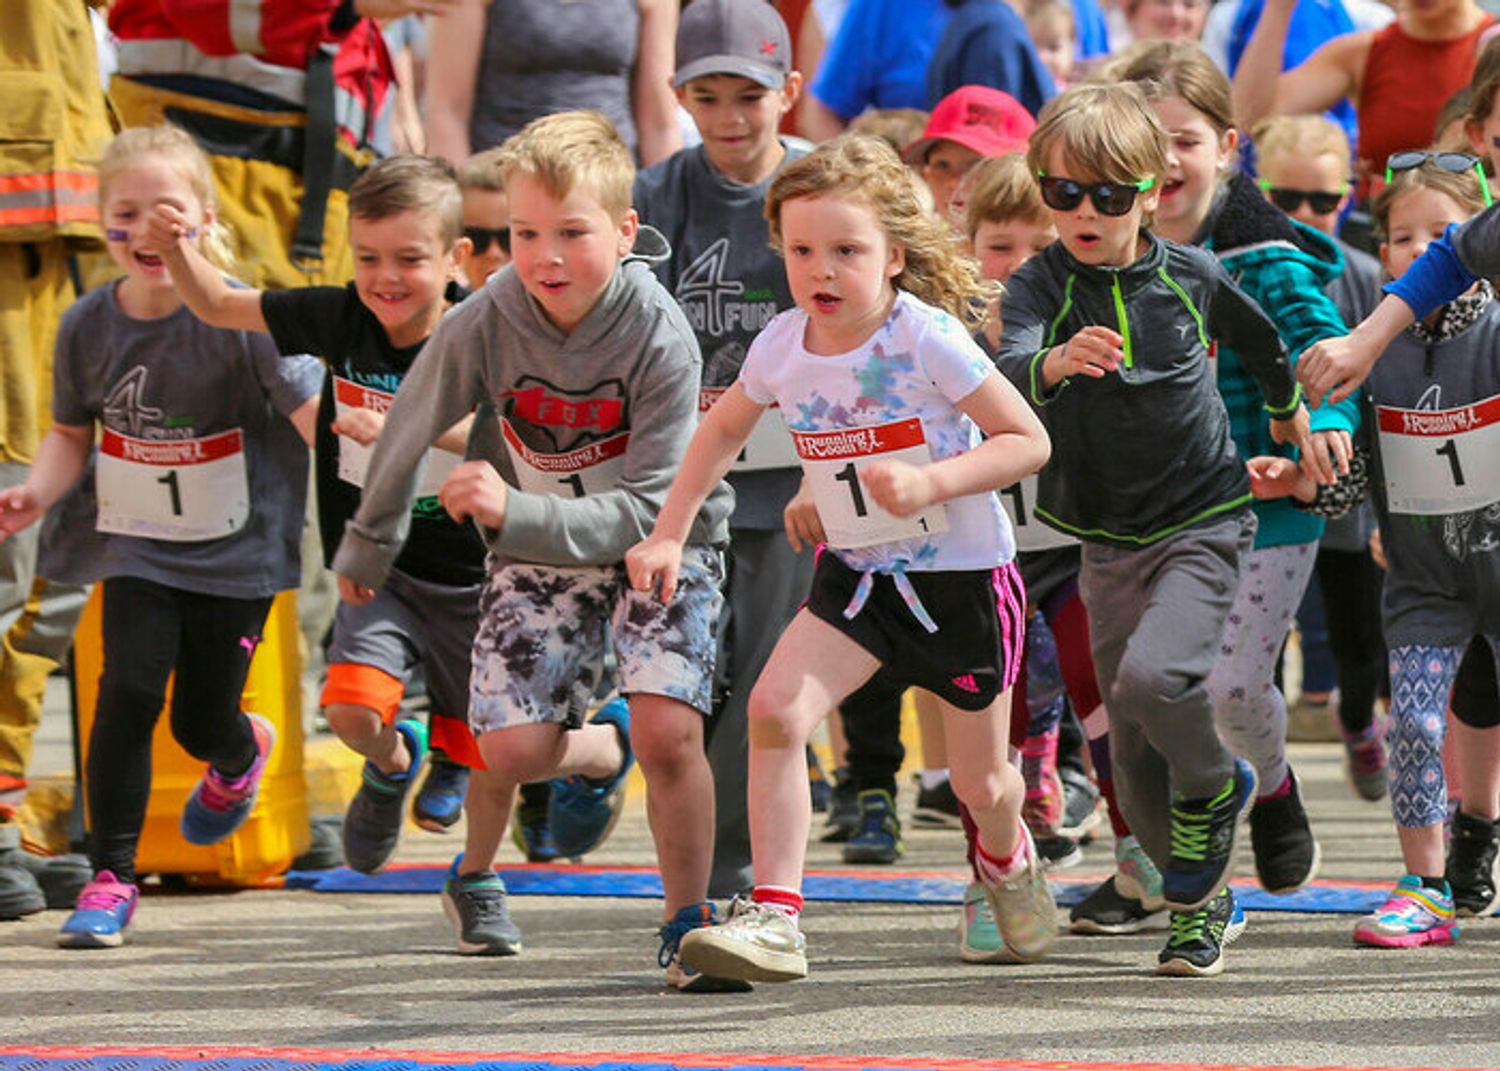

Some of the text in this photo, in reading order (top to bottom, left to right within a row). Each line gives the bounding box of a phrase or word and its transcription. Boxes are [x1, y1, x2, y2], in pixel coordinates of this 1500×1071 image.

[538, 401, 603, 424] FOX
[1411, 411, 1467, 434] Running
[805, 431, 867, 456] Running
[1436, 439, 1465, 487] 1
[157, 470, 182, 515] 1
[835, 463, 867, 517] 1
[1001, 481, 1027, 526] 1
[918, 517, 929, 532] 1
